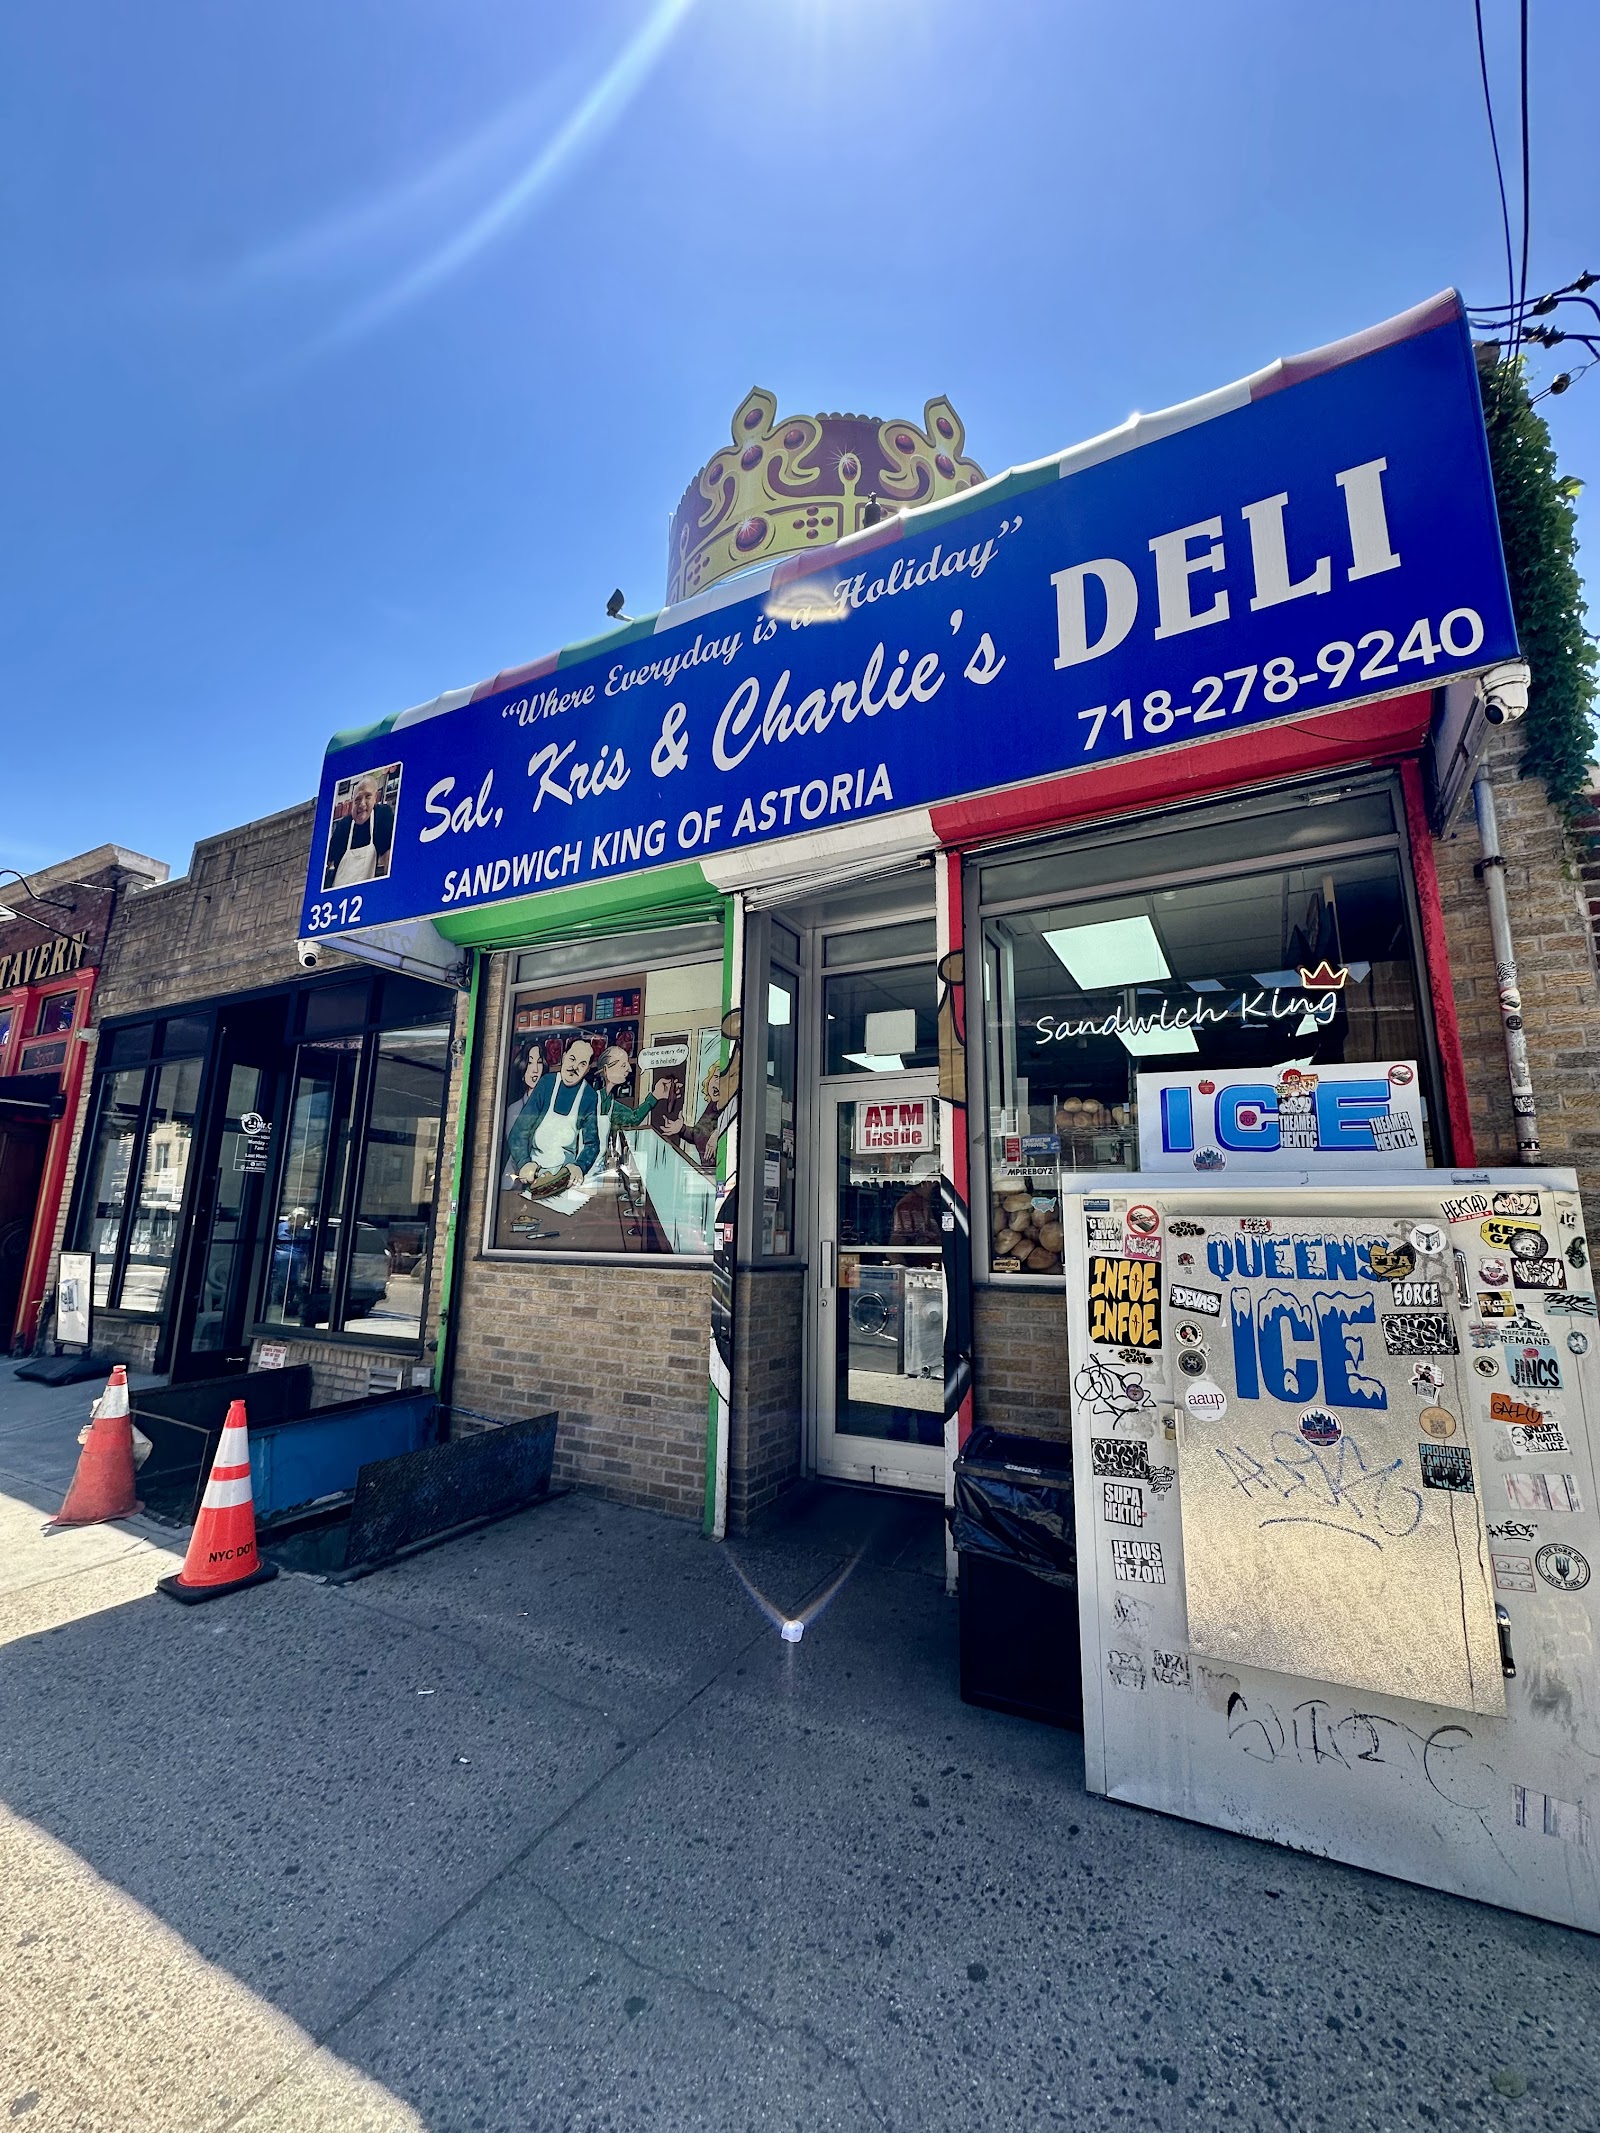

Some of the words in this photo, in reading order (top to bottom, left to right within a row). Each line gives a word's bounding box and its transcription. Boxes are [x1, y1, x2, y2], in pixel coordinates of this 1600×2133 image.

[1051, 457, 1401, 670] DELI
[604, 632, 743, 696] Everyday
[753, 613, 779, 645] is
[790, 608, 813, 631] a
[1078, 608, 1484, 750] 718-278-9240
[420, 768, 503, 843] Sal,
[528, 739, 630, 812] Kris
[651, 703, 688, 777] &
[442, 841, 582, 902] SANDWICH
[591, 820, 666, 869] KING
[678, 805, 723, 848] OF
[732, 763, 893, 837] ASTORIA
[308, 896, 362, 931] 33-12
[1035, 998, 1229, 1045] Sandwich
[1240, 989, 1337, 1024] King
[864, 1103, 924, 1128] ATM
[1160, 1079, 1390, 1153] ICE
[865, 1127, 922, 1147] Inside
[1280, 1131, 1318, 1147] HEKTIC
[1374, 1129, 1417, 1151] HEKTIC
[1207, 1231, 1392, 1282] QUEENS
[1091, 1258, 1160, 1302] INFOE
[1172, 1287, 1221, 1313] DEVAS
[1394, 1283, 1440, 1306] SORCE
[1091, 1300, 1160, 1345] INFOE
[1231, 1287, 1387, 1409] ICE
[1500, 1335, 1550, 1346] REMAND
[1188, 1393, 1225, 1410] aaup
[1524, 1423, 1559, 1434] SNOOPY
[1535, 1432, 1564, 1443] HATES
[1419, 1444, 1470, 1459] BROOKLYN
[1104, 1484, 1141, 1507] SUPA
[1104, 1501, 1142, 1526] HEKTIC
[209, 1549, 234, 1562] NYC
[237, 1541, 254, 1557] DOT
[1113, 1540, 1161, 1560] JELOUS
[1115, 1563, 1165, 1584] NEZOH
